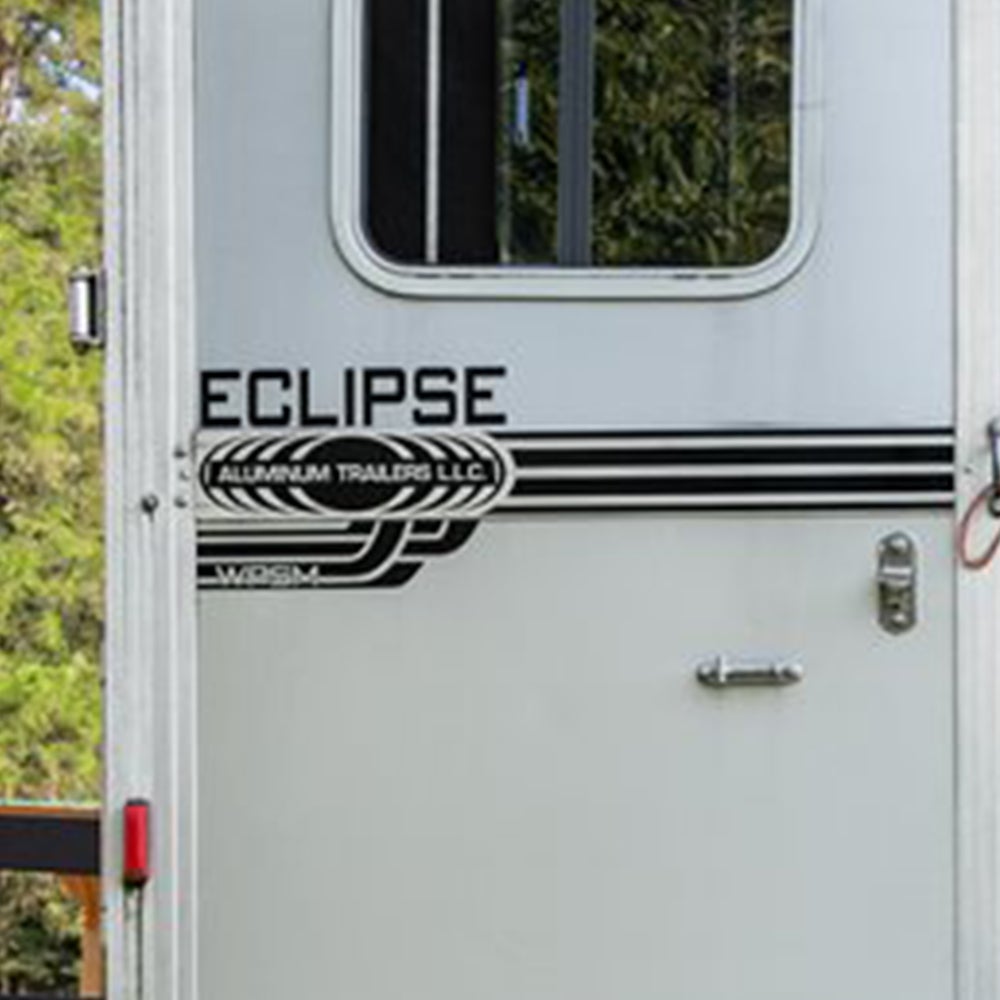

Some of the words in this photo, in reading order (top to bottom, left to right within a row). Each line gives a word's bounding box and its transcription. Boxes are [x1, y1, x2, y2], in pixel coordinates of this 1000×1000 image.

[200, 367, 507, 427] ECLIPSE
[217, 463, 331, 484] ALUMINUM
[335, 462, 432, 483] TRAILERS
